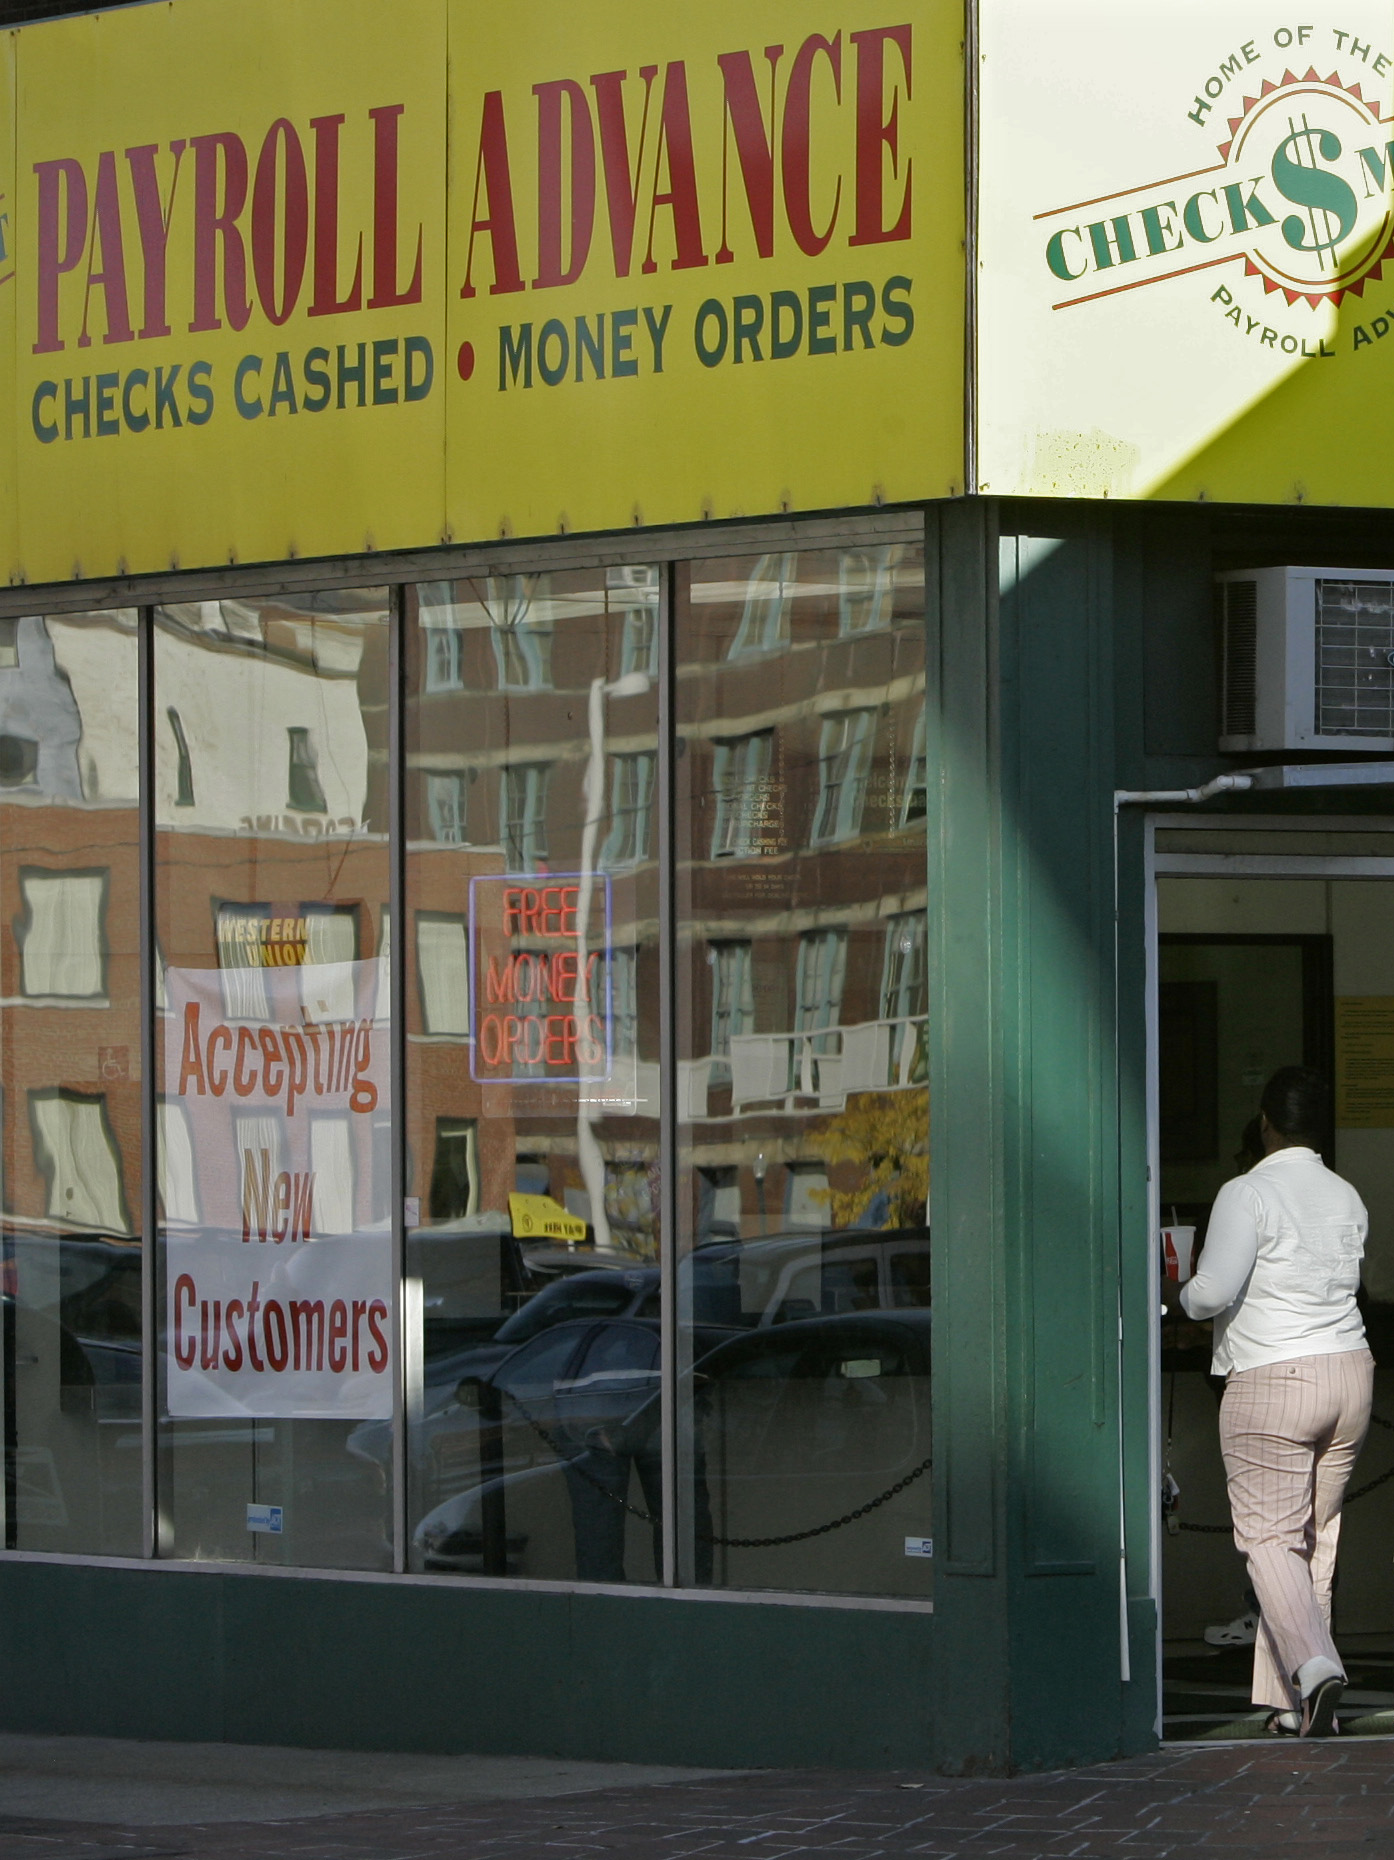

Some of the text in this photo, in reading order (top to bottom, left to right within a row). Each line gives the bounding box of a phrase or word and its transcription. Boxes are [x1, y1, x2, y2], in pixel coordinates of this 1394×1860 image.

[1187, 26, 1393, 128] HOME OF THE
[32, 23, 913, 355] PAYROLL ADVANCE
[31, 275, 916, 444] CHECKS CASHED MONEY ORDERS
[1210, 284, 1336, 358] PAYROLL
[219, 918, 309, 943] WESTERN
[503, 887, 583, 938] FREE
[246, 944, 312, 967] UNION
[486, 951, 600, 1003] MONEY
[178, 1001, 379, 1117] Accepting
[481, 1015, 604, 1066] ORDERS
[241, 1148, 316, 1244] New
[173, 1273, 389, 1375] Customers
